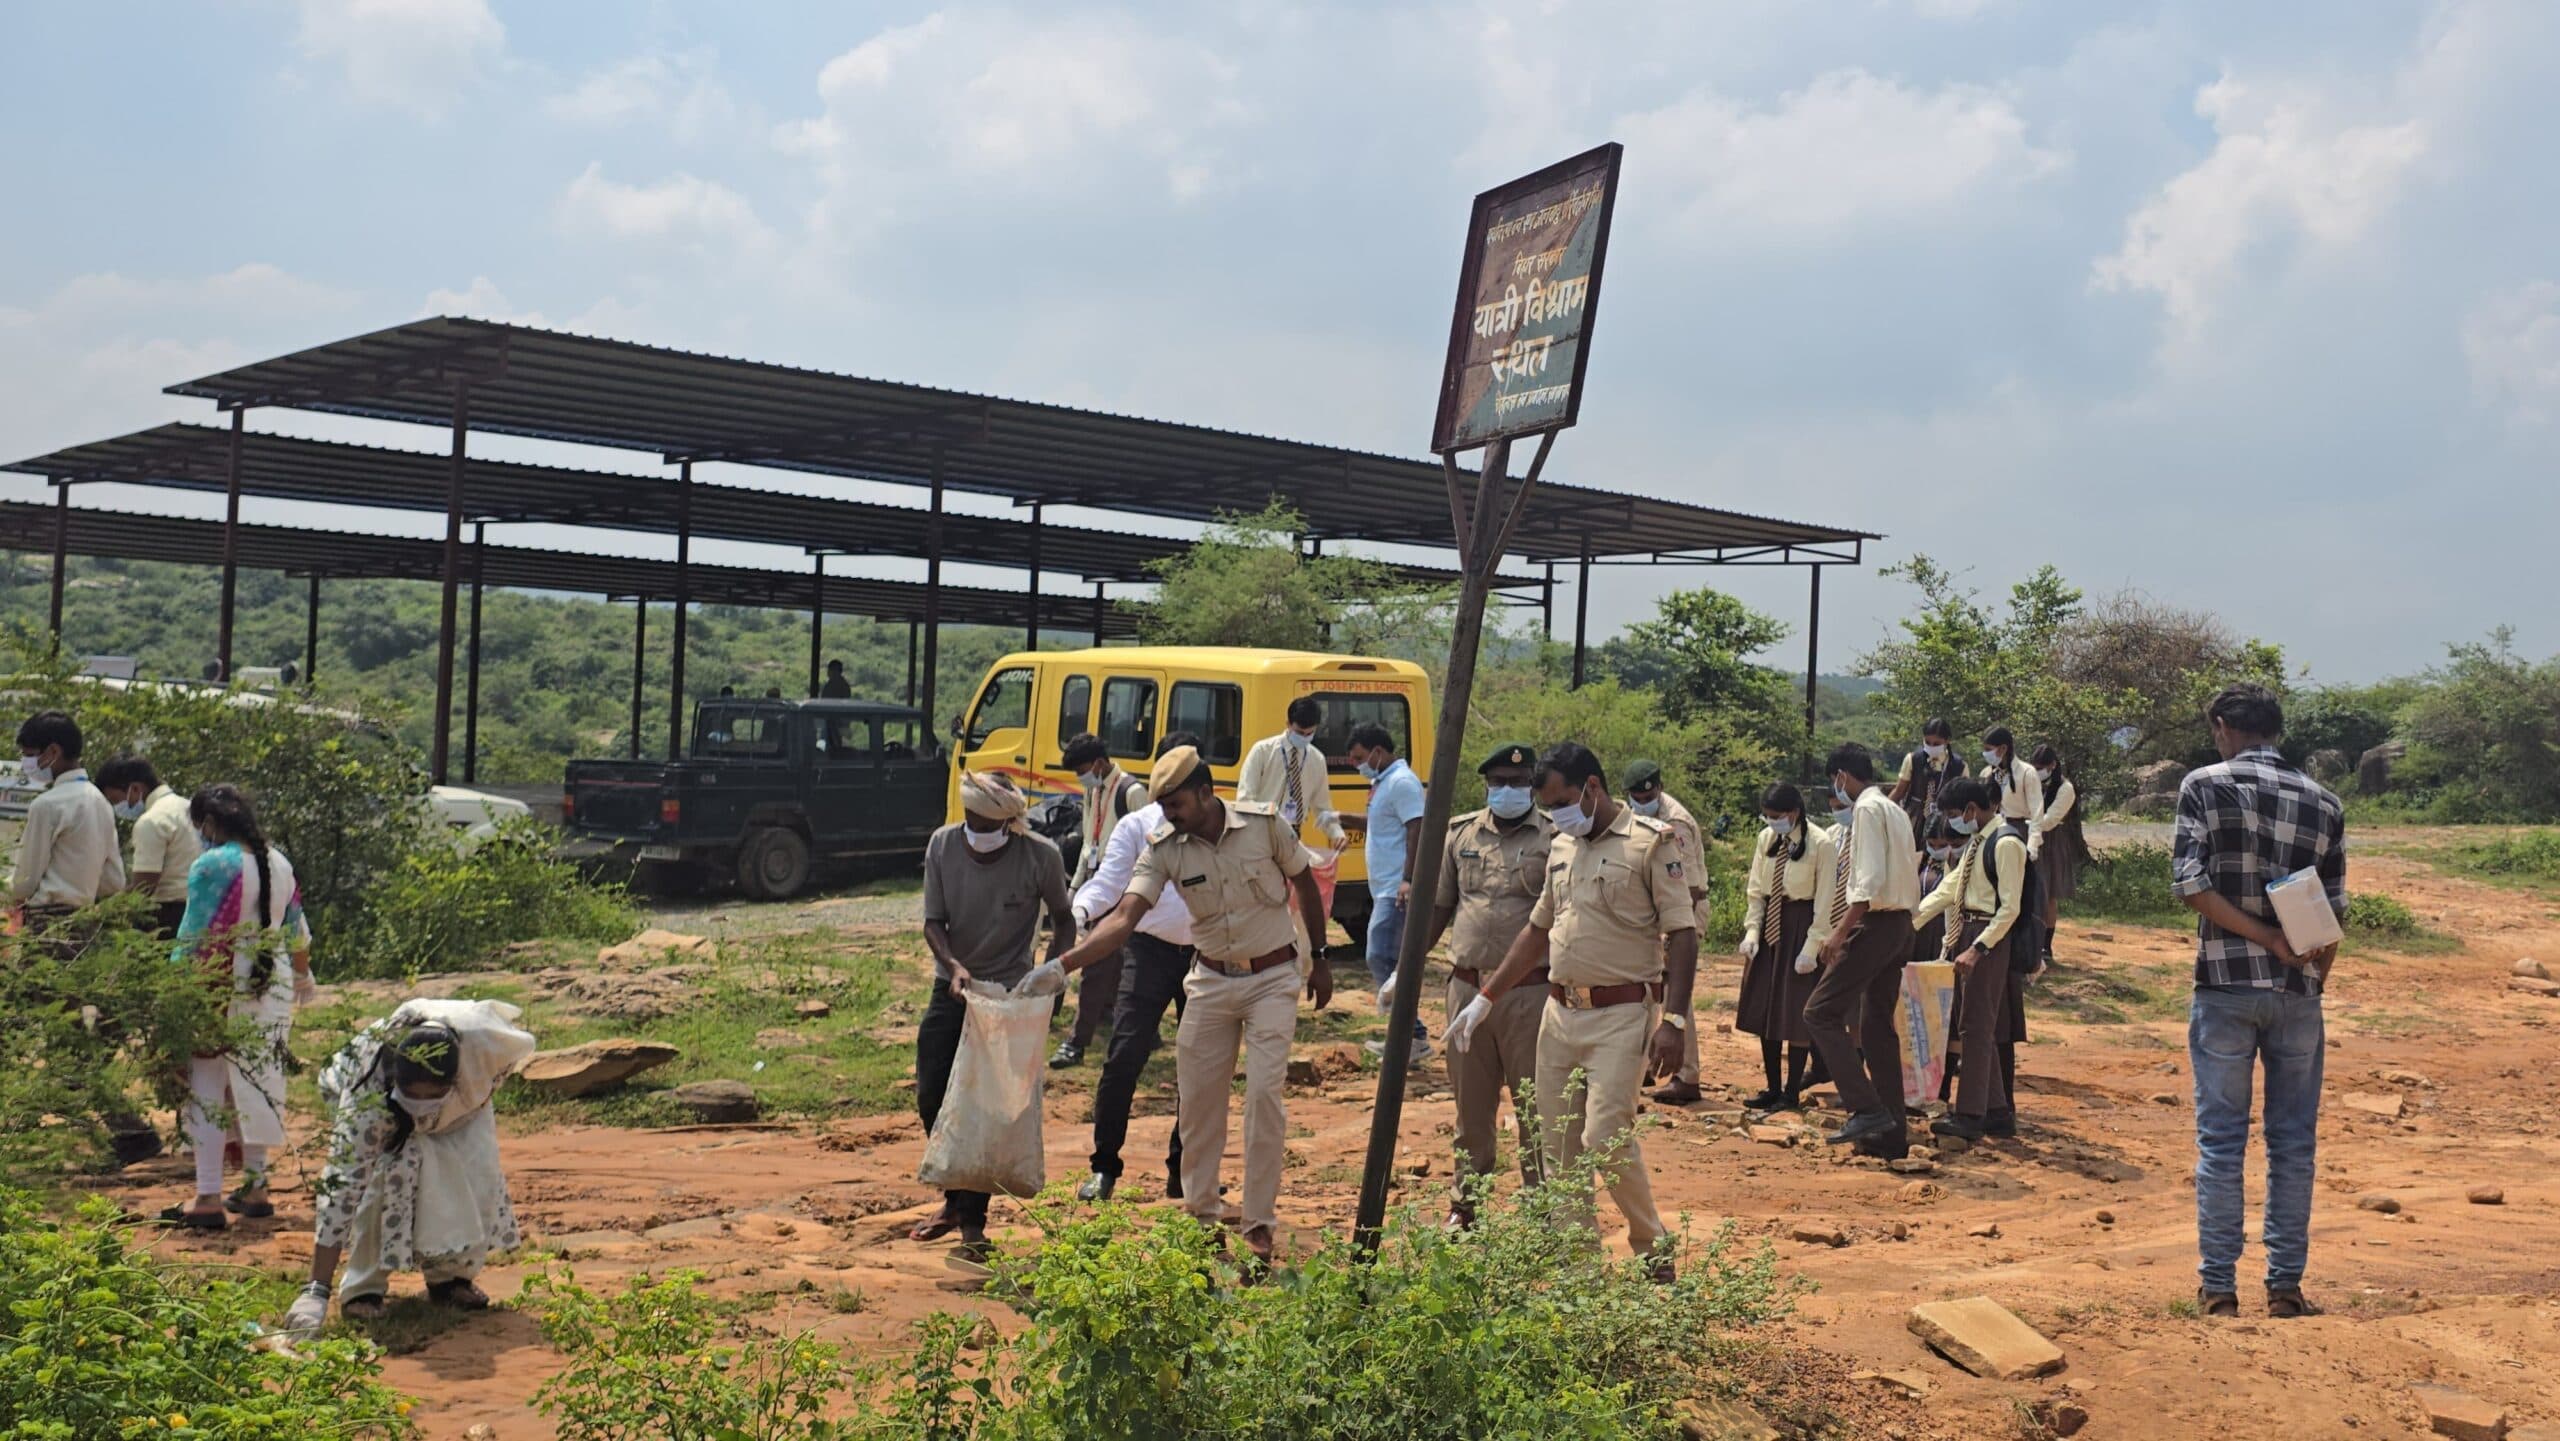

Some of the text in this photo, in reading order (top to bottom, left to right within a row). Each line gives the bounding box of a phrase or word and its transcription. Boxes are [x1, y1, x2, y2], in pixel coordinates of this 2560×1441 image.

[1474, 277, 1590, 339] यात्री विश्राम
[1323, 681, 1370, 692] JOSEPH'S
[1376, 683, 1410, 693] SCHOOL
